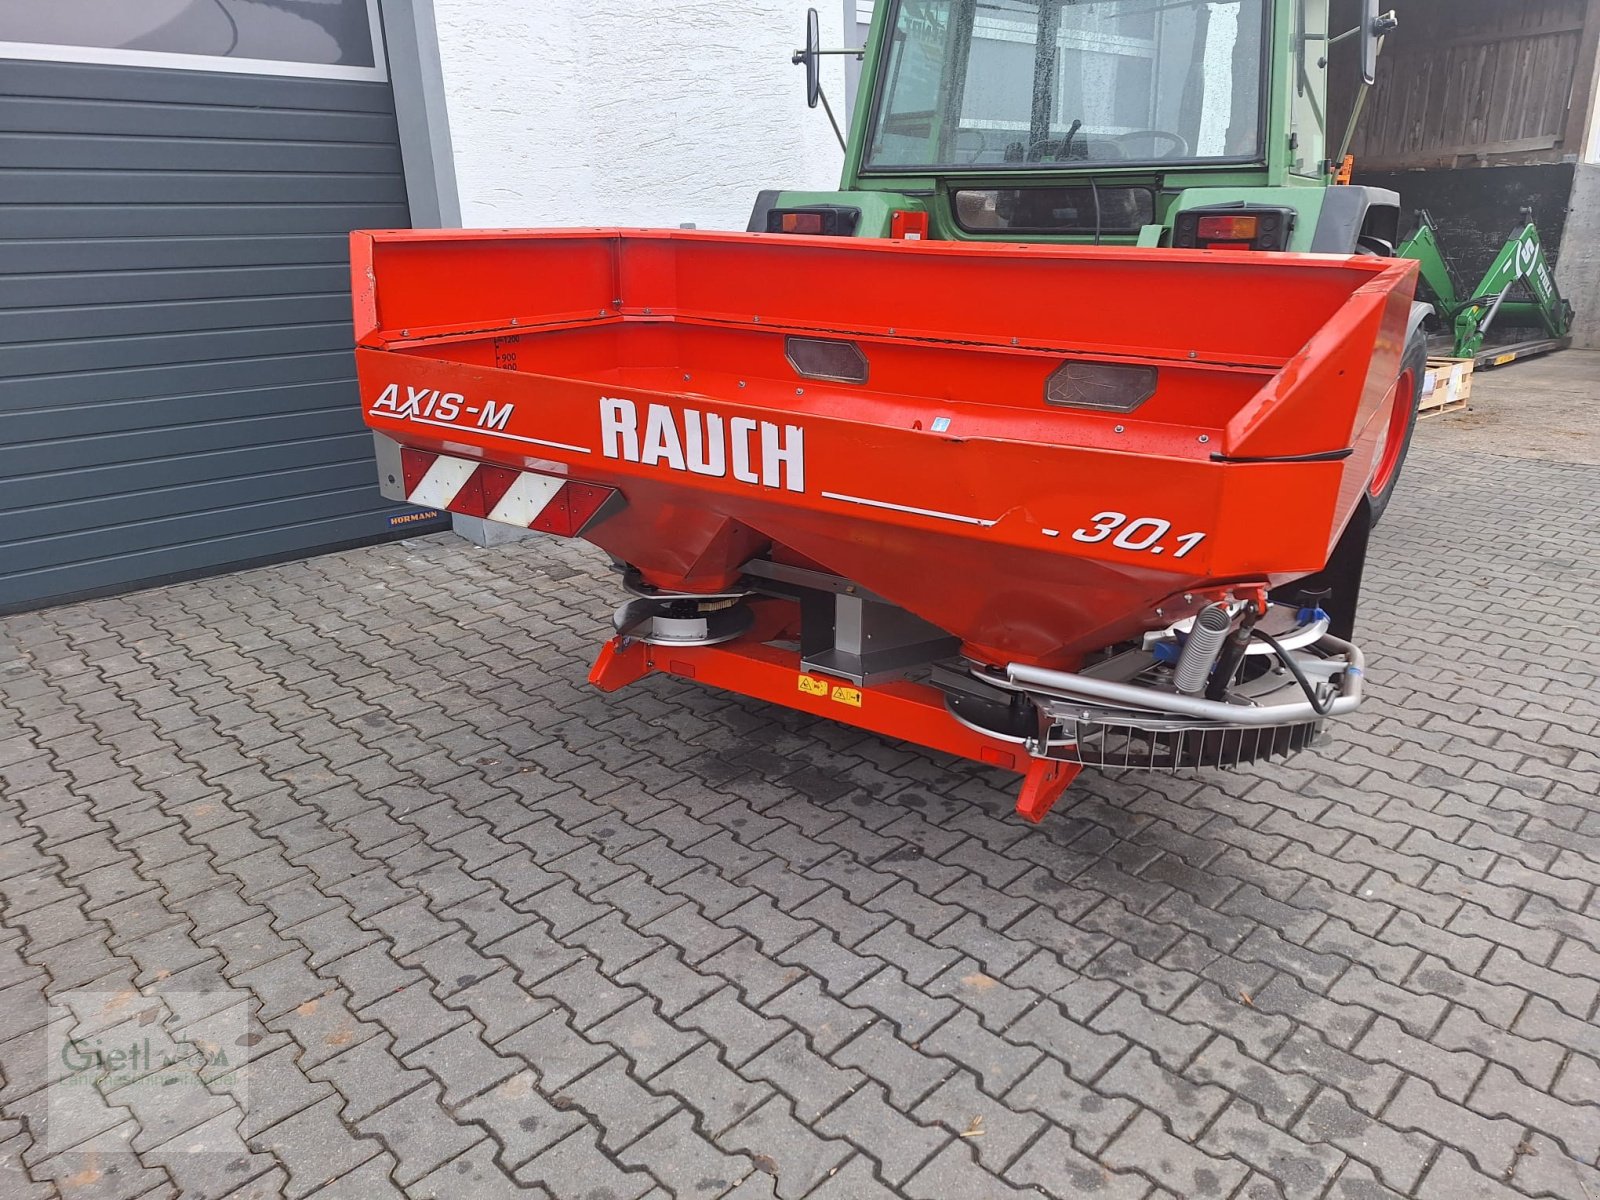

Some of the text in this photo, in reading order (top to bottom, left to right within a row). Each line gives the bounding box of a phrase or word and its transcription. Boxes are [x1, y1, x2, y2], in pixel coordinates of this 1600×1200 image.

[501, 353, 517, 362] 900
[373, 383, 515, 430] AXIS-M
[601, 397, 806, 493] RAUCH
